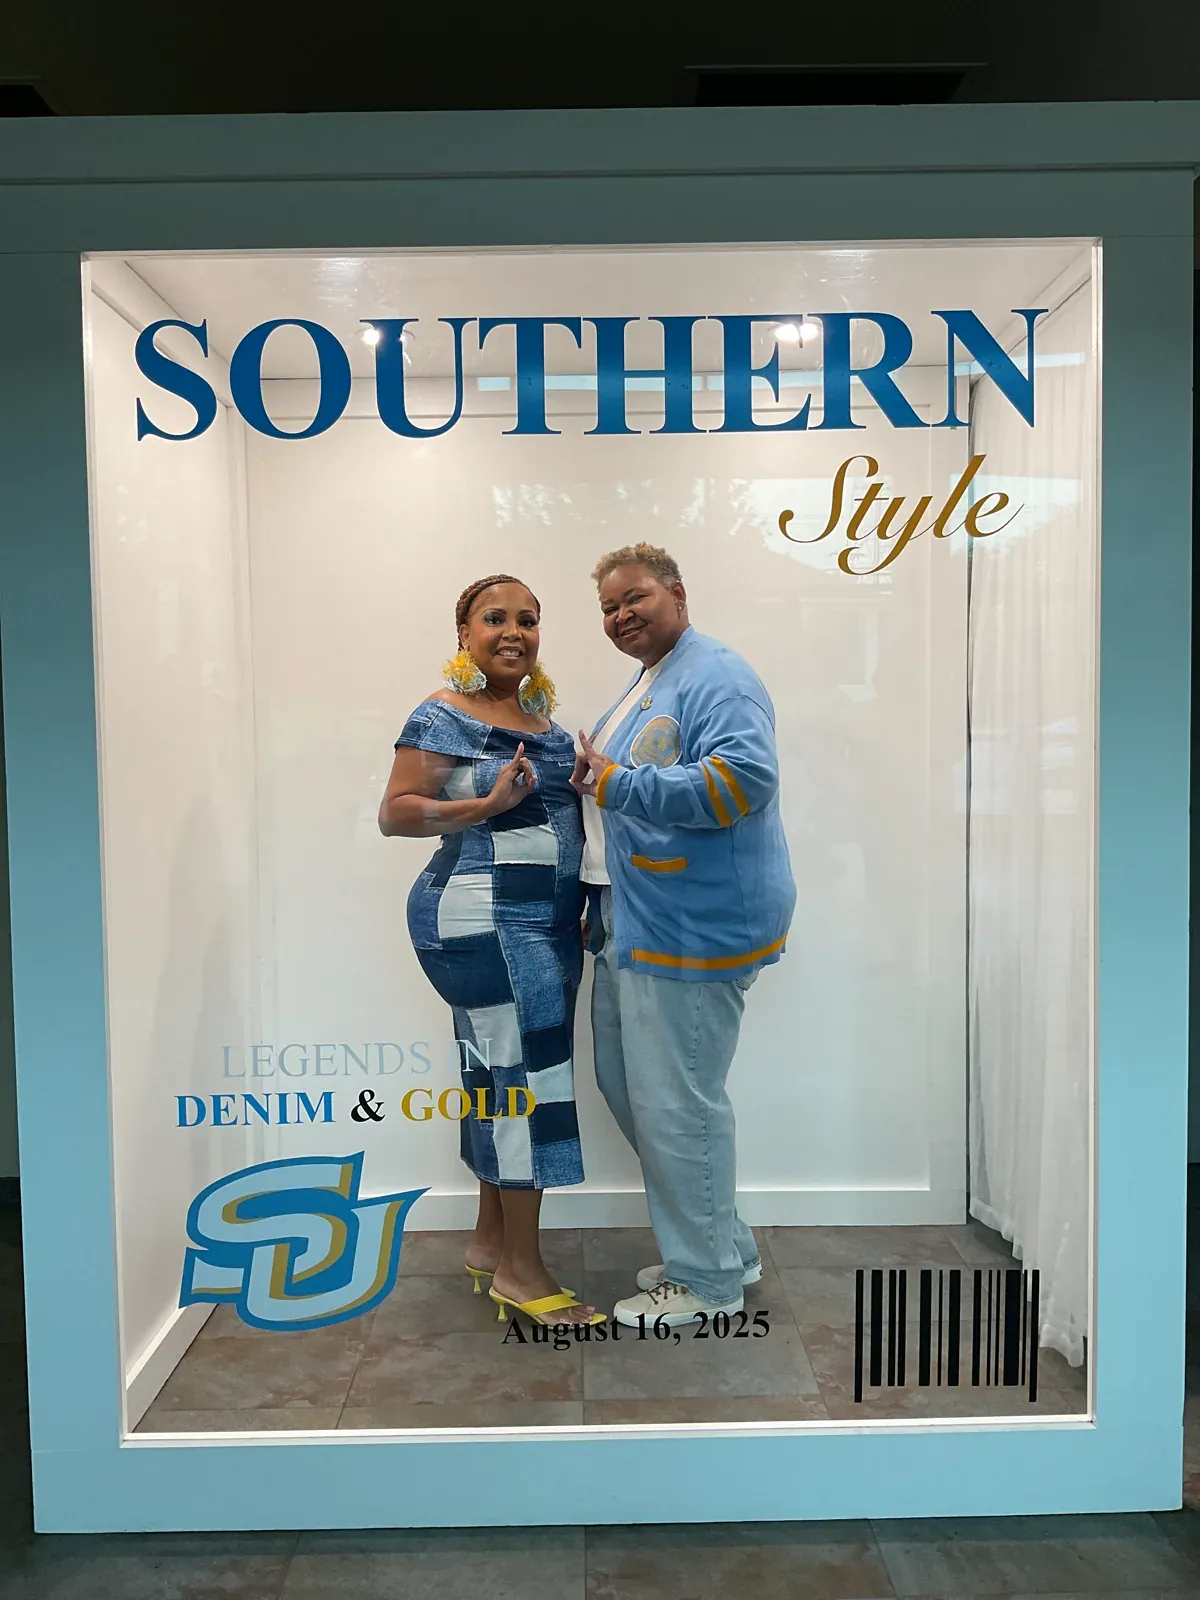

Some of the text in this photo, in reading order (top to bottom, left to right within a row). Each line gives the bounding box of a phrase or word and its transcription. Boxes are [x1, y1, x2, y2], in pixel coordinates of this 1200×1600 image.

[134, 308, 1049, 442] SOUTHERN
[778, 454, 1024, 575] Style
[221, 1038, 493, 1078] LEGENDS IN
[174, 1086, 536, 1128] DENIM & GOLD
[501, 1310, 770, 1351] August 16, 2025
